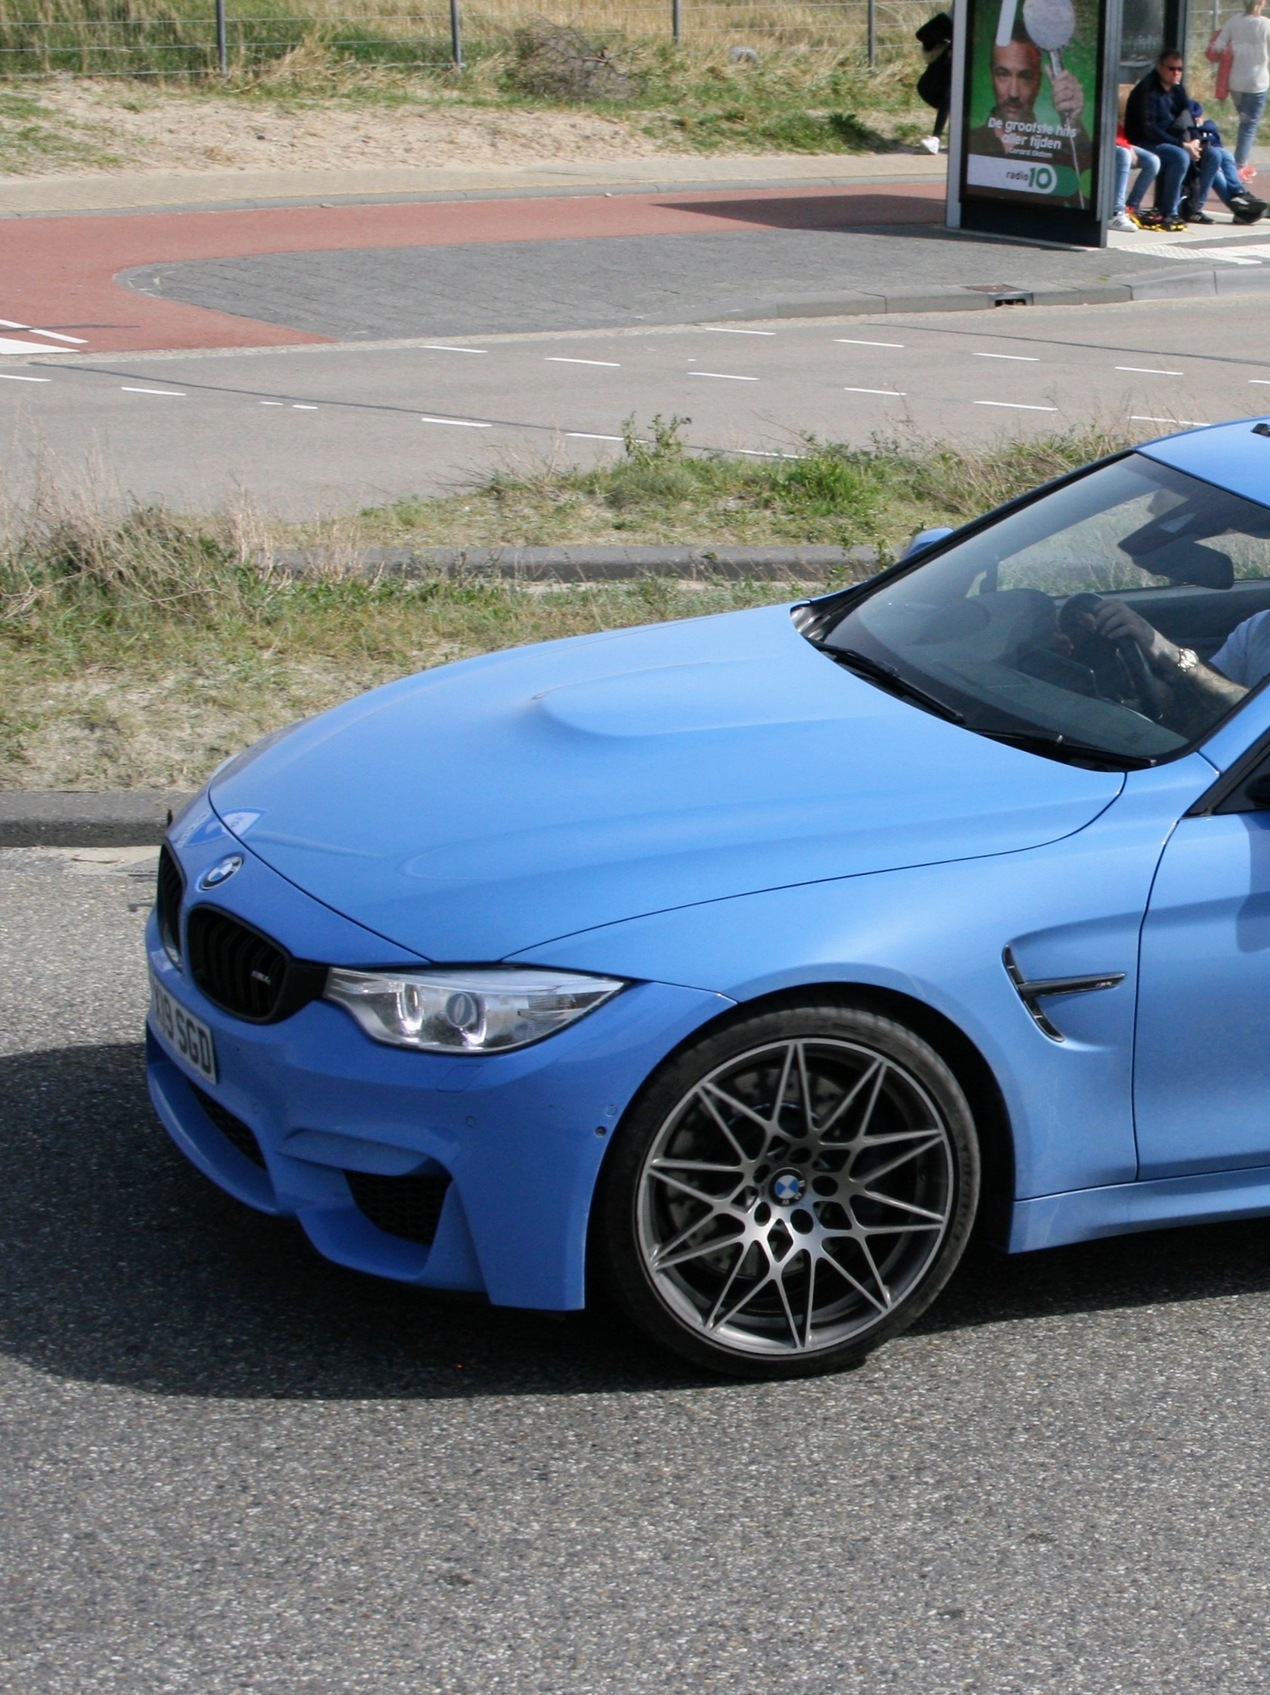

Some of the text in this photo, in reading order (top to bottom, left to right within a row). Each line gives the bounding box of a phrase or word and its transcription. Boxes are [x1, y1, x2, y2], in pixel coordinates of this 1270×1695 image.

[988, 117, 1003, 129] De
[1005, 120, 1054, 135] grootste
[1030, 134, 1062, 150] tijden
[175, 1008, 212, 1075] SGD
